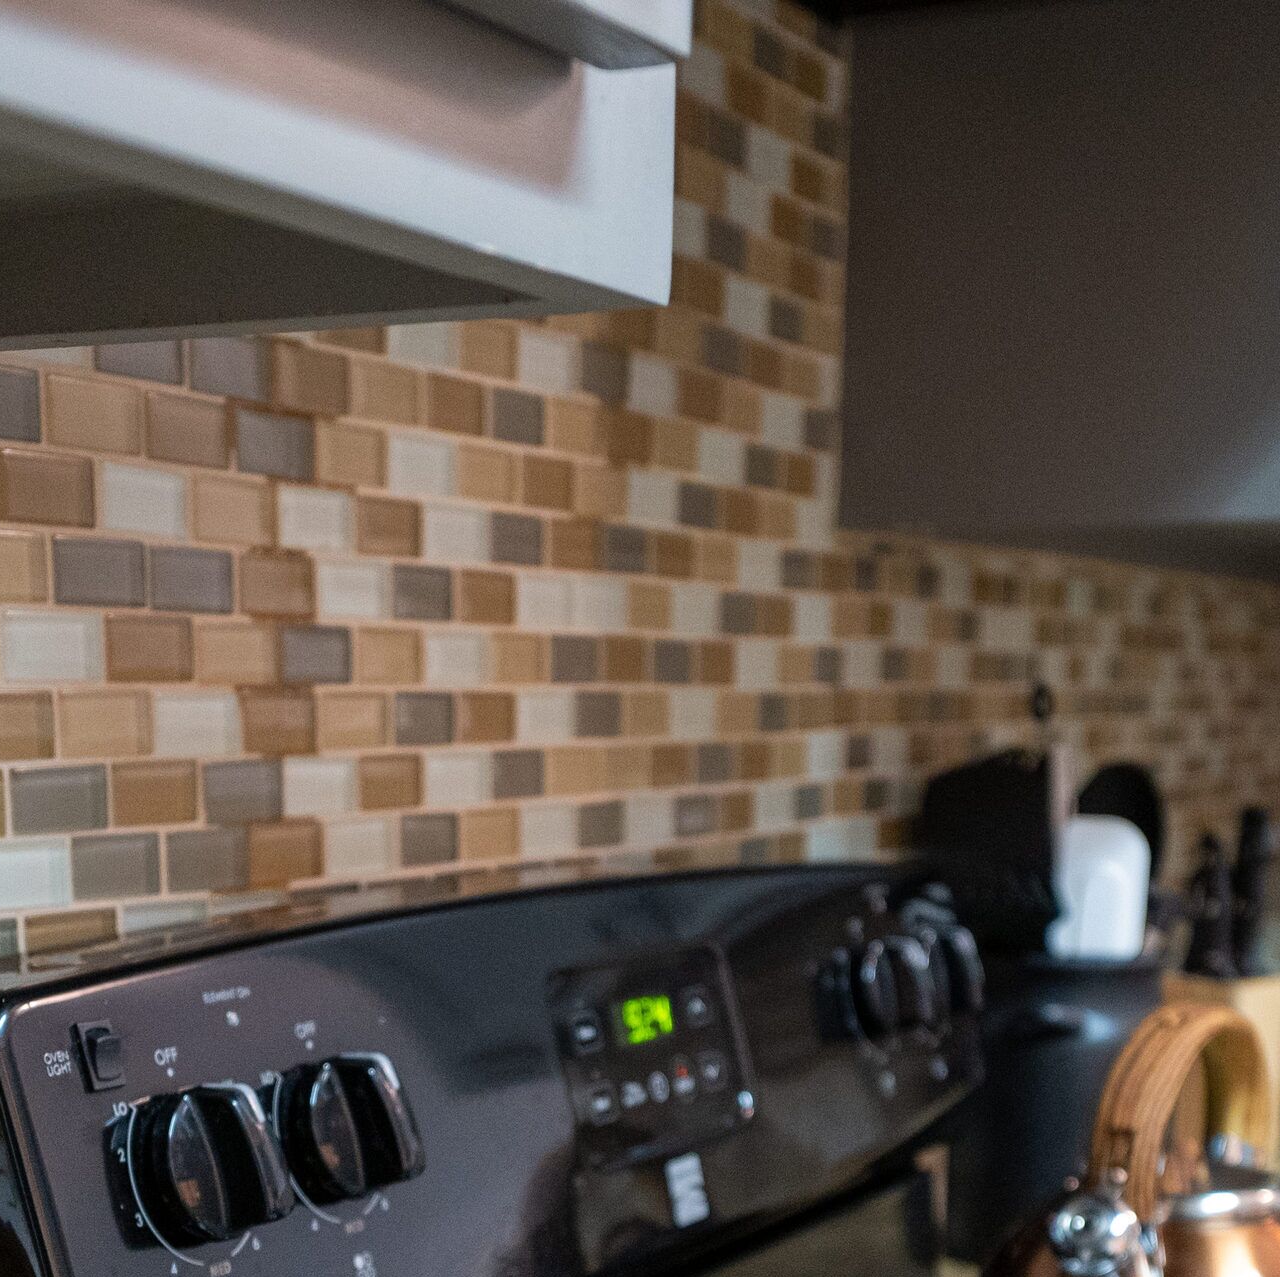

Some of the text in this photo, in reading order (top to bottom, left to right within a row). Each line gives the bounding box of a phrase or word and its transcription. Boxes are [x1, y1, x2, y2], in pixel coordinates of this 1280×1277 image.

[43, 1050, 69, 1065] OVEN
[154, 1046, 178, 1066] OFF
[46, 1063, 71, 1077] LIGHT
[112, 1102, 128, 1116] LO
[117, 1149, 126, 1162] 2
[134, 1213, 144, 1228] 3
